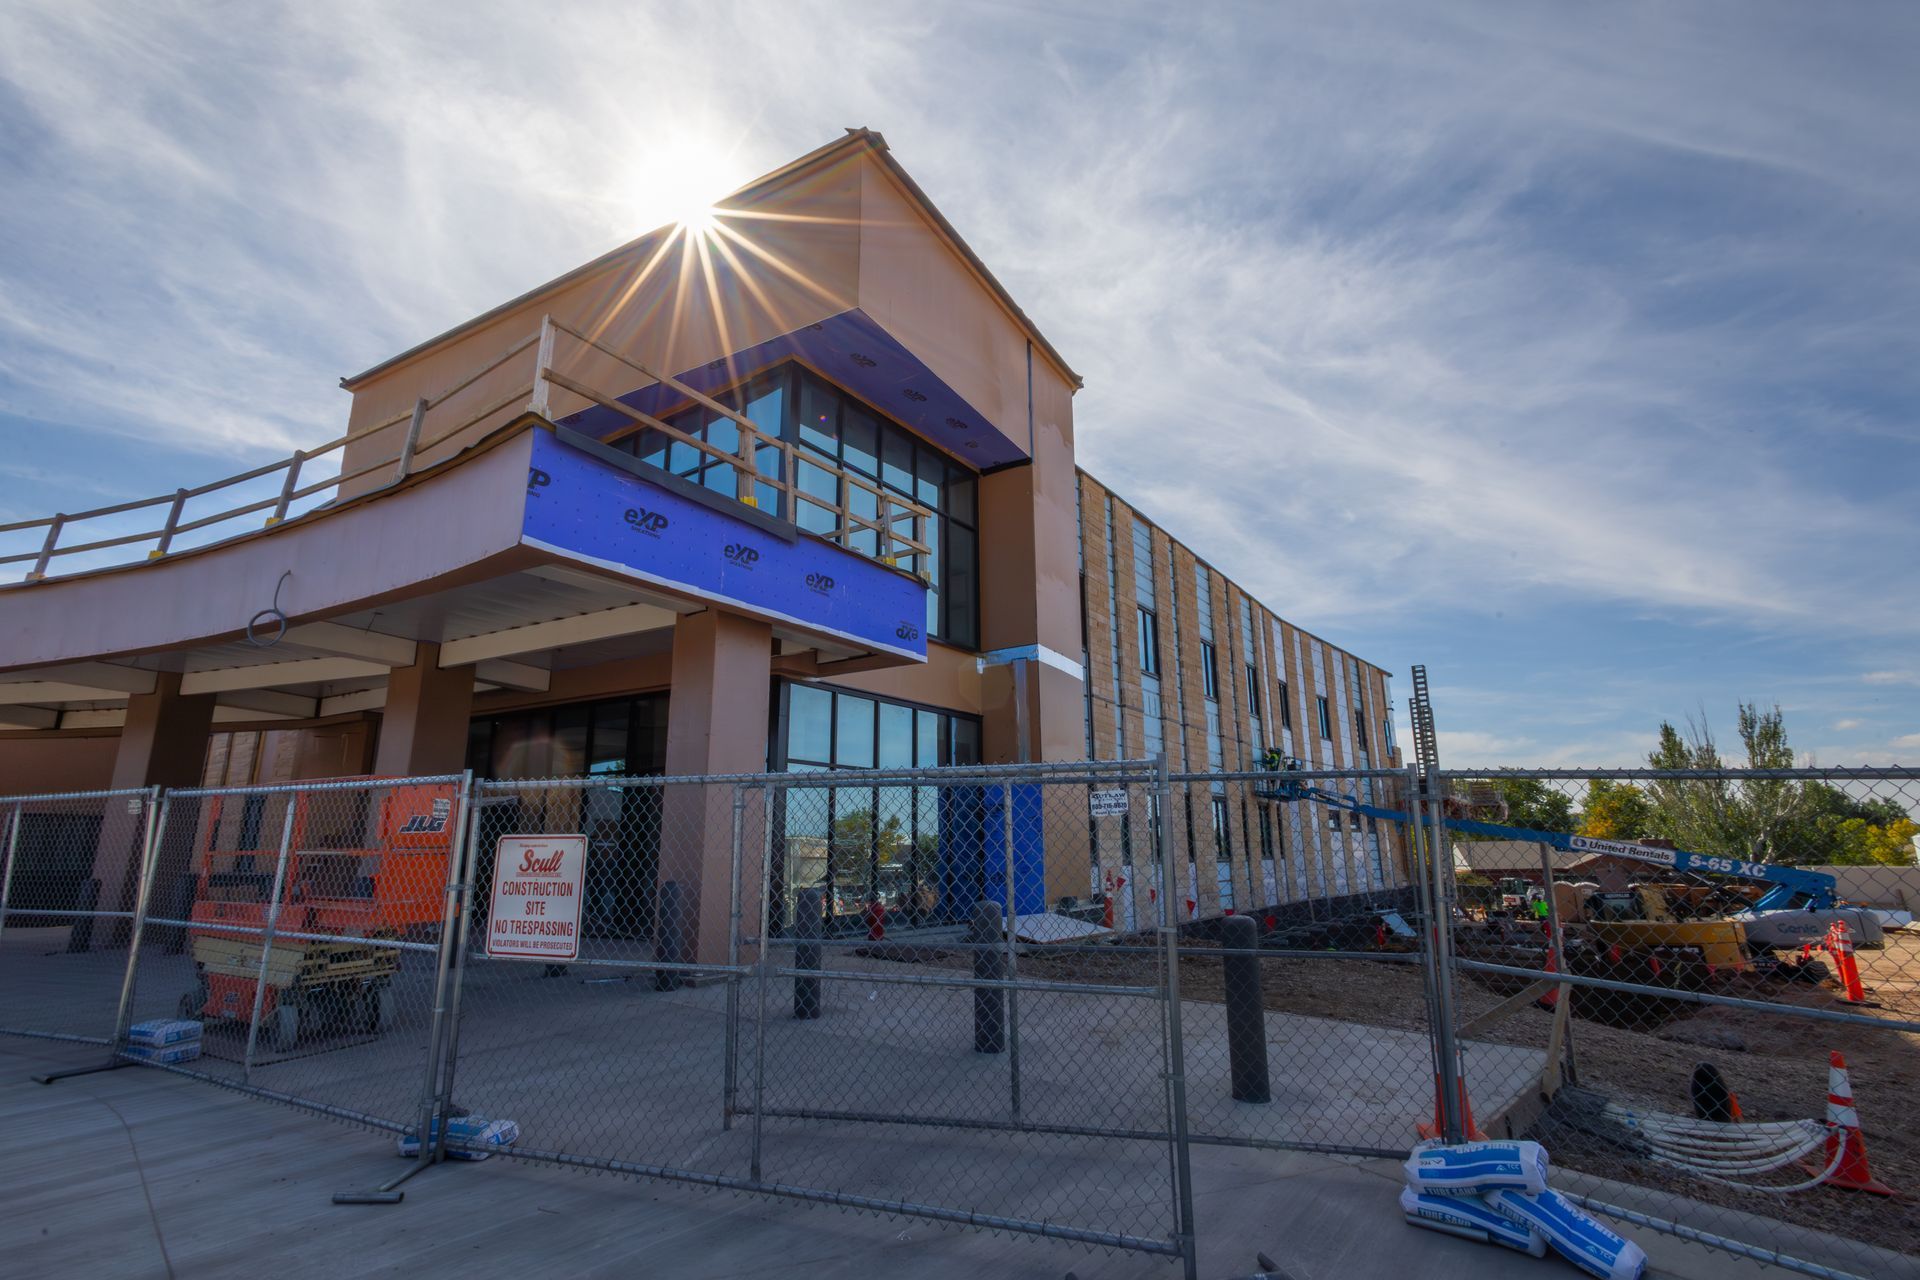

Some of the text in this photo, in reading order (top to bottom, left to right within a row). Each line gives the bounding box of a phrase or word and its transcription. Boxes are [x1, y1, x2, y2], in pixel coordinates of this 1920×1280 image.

[399, 814, 448, 834] JLG
[1588, 841, 1671, 862] United Rentals
[519, 849, 564, 873] Scull
[1689, 854, 1767, 877] S-65 XC
[502, 881, 574, 897] CONSTRUCTION
[525, 901, 546, 915] SITE
[494, 920, 574, 937] NO TRESPASSING
[492, 939, 573, 950] VIOLATORS WILL BE PROSECUTED
[1420, 1207, 1443, 1221] TUBE
